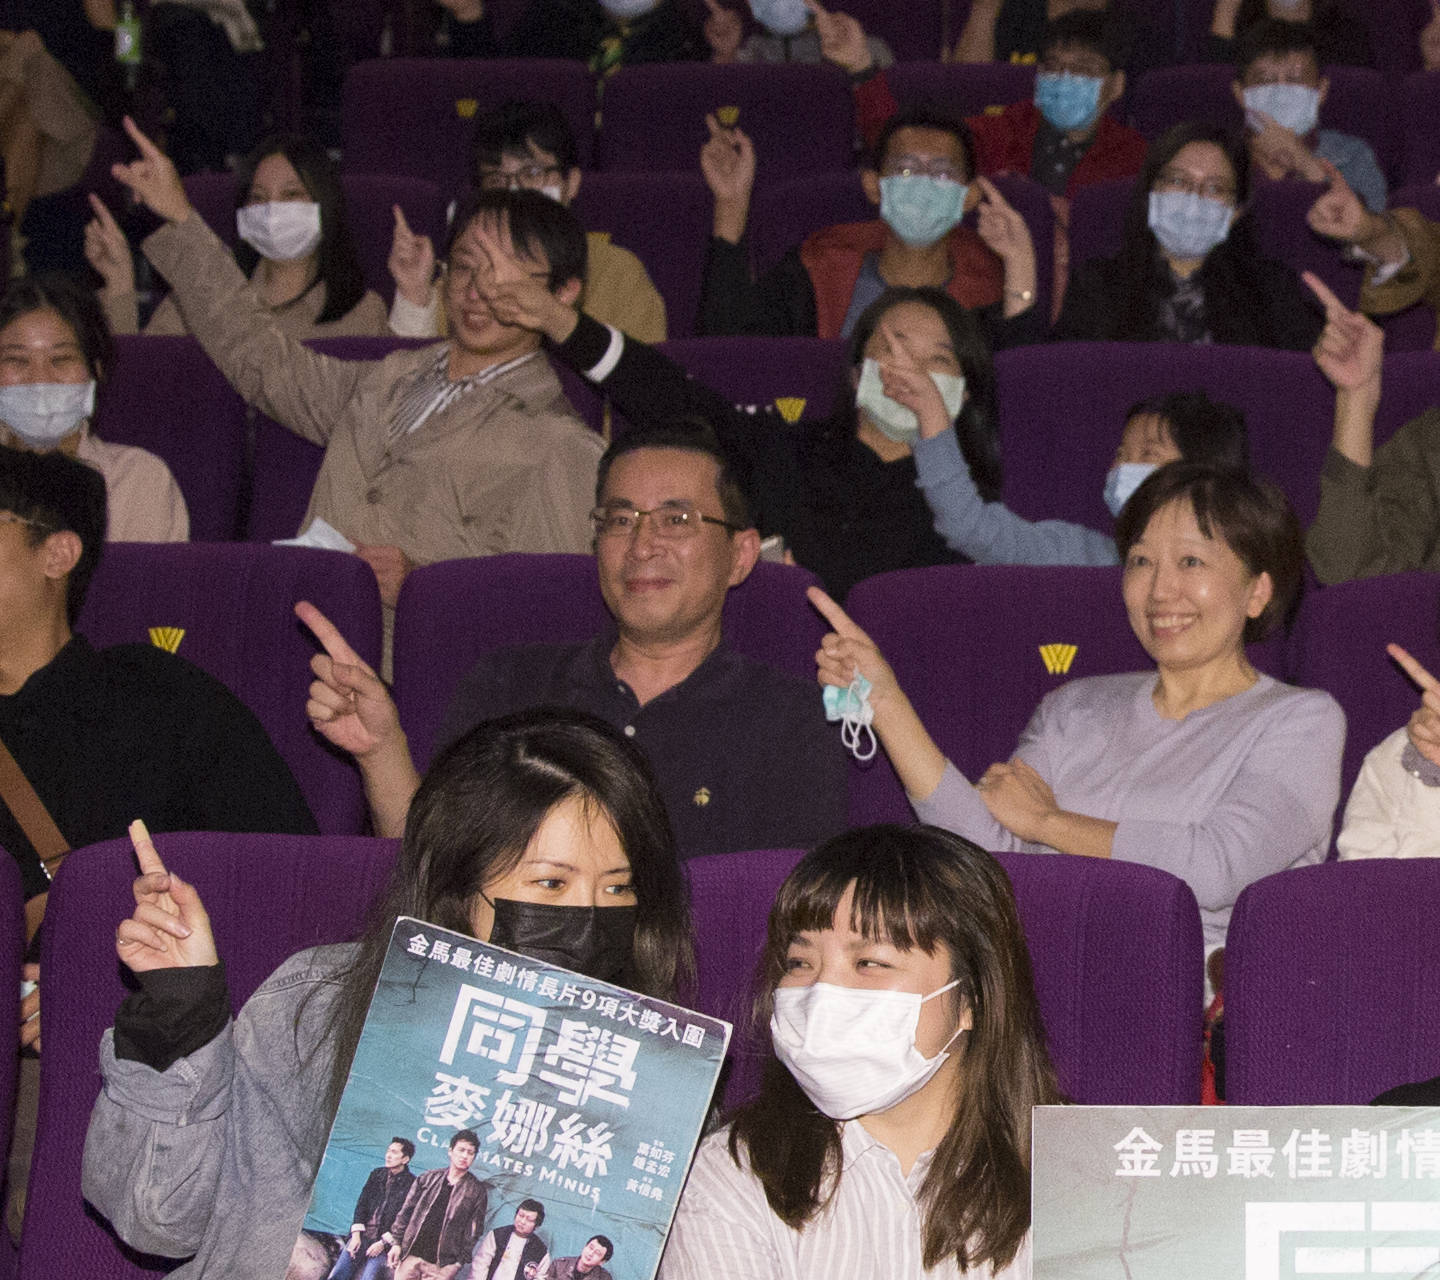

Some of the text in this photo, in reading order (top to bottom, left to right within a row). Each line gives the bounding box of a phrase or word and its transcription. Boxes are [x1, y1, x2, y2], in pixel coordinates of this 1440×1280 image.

[438, 982, 642, 1110] 同學
[416, 1126, 602, 1200] CLAMATES MINUS
[425, 1071, 615, 1180] 麥娜絲
